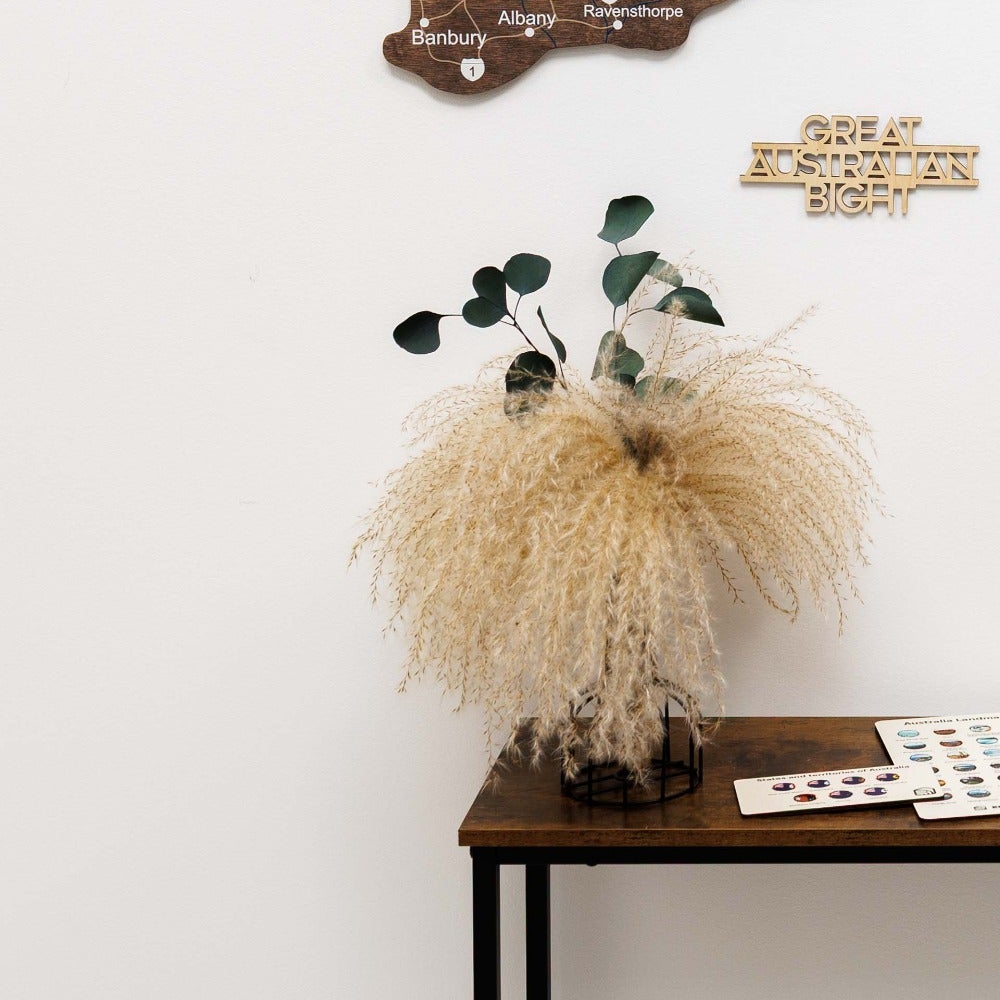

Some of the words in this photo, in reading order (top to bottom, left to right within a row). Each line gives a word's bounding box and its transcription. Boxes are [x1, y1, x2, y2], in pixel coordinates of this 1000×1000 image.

[498, 10, 555, 29] Albany
[584, 5, 683, 20] Ravensthorpe
[412, 30, 486, 49] Banbury
[800, 115, 922, 147] GREAT
[745, 149, 974, 184] AUSTRALIAN
[805, 181, 910, 214] BIGHT
